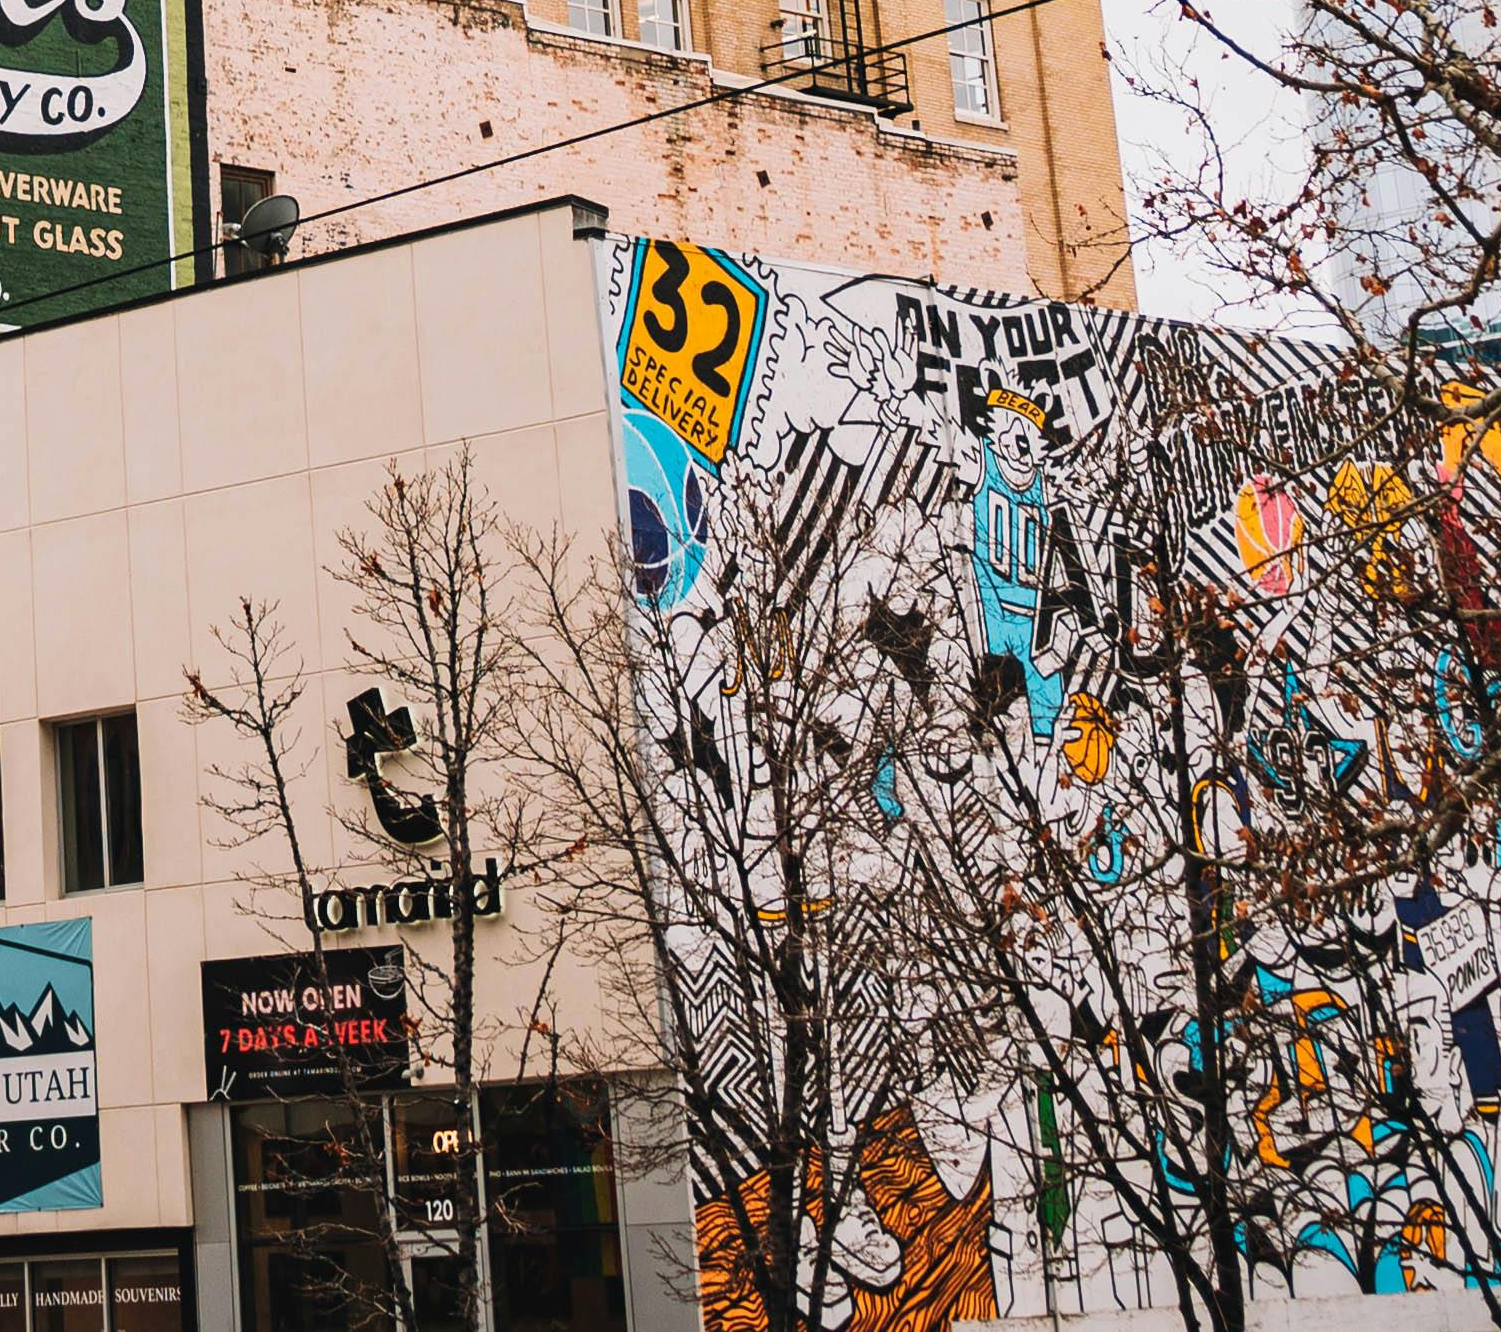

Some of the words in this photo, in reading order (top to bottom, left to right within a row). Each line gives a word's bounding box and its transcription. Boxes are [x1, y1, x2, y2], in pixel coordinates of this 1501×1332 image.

[41, 85, 107, 124] CO.
[33, 220, 124, 260] GLASS
[644, 240, 740, 398] 32
[969, 303, 1080, 365] YOUR
[630, 346, 719, 429] SPECIAL
[627, 369, 719, 448] DELIVERY
[996, 392, 1041, 422] BEAR
[304, 858, 501, 932] tamarid
[1447, 946, 1490, 1002] POINTS
[241, 989, 295, 1016] NOW
[219, 1029, 231, 1054] 7
[238, 1024, 296, 1053] DAYS
[304, 1026, 319, 1047] A
[327, 1019, 388, 1046] WEEK
[2, 1067, 91, 1104] UTAH
[30, 1124, 81, 1151] CO.
[432, 1129, 473, 1154] OPE
[426, 1199, 454, 1222] 120
[35, 1289, 104, 1307] HANDMADE
[114, 1287, 181, 1304] SOUVENIRS
